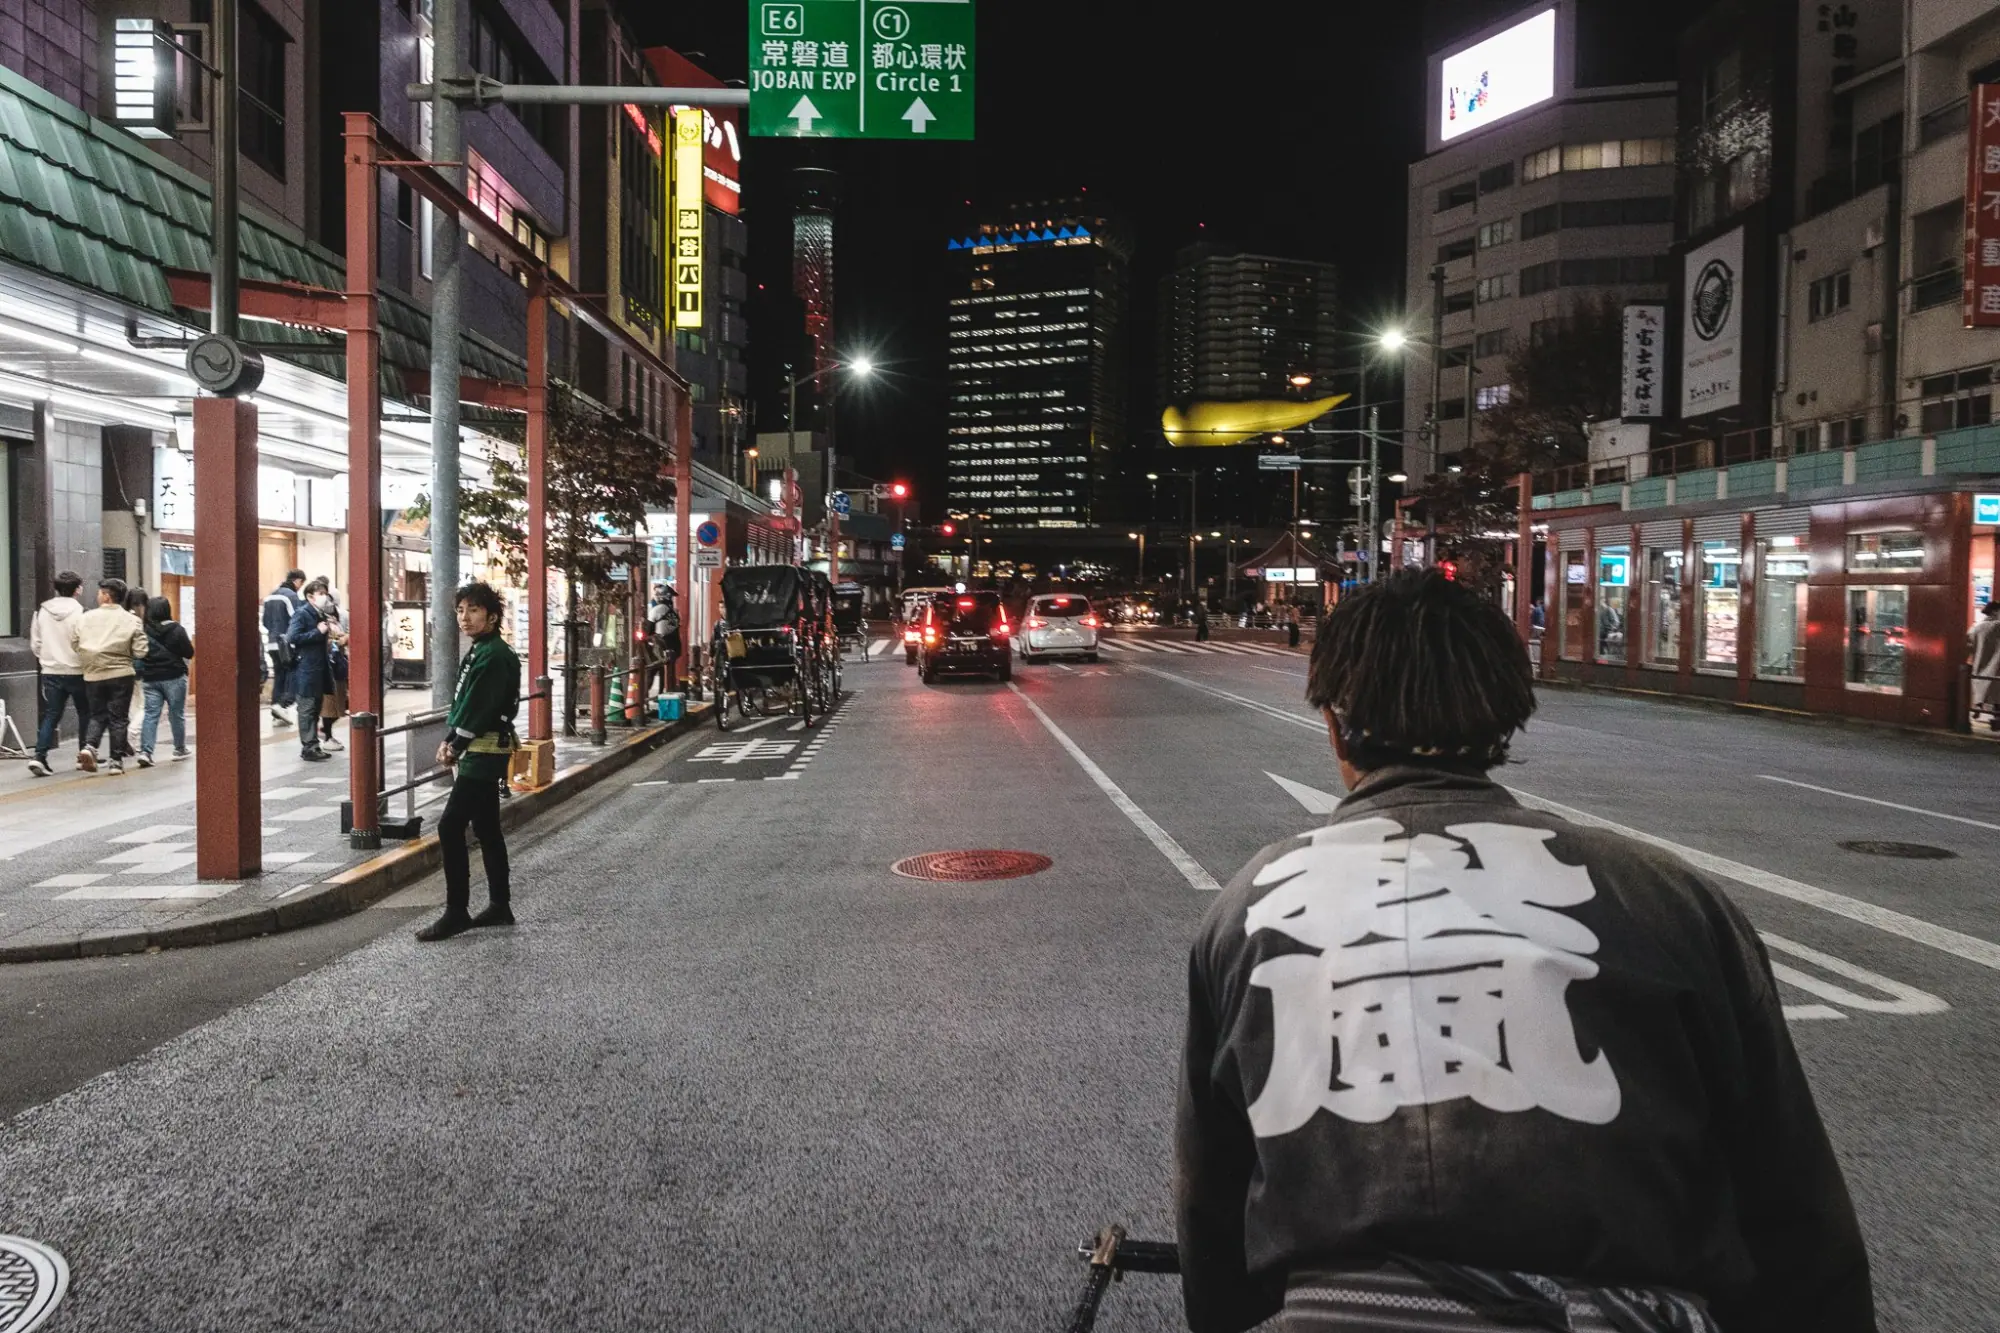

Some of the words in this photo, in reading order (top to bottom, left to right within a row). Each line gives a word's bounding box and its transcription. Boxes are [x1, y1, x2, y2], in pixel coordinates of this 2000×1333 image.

[769, 10, 798, 30] E6
[879, 13, 902, 33] C1
[762, 40, 849, 68] 常磐道
[872, 42, 967, 70] 都心環状
[752, 70, 814, 92] JOBAN
[822, 71, 857, 91] EXP
[876, 72, 940, 92] Circle
[950, 74, 963, 92] 1
[679, 210, 699, 311] 神谷バー
[1635, 328, 1656, 400] 富士そば
